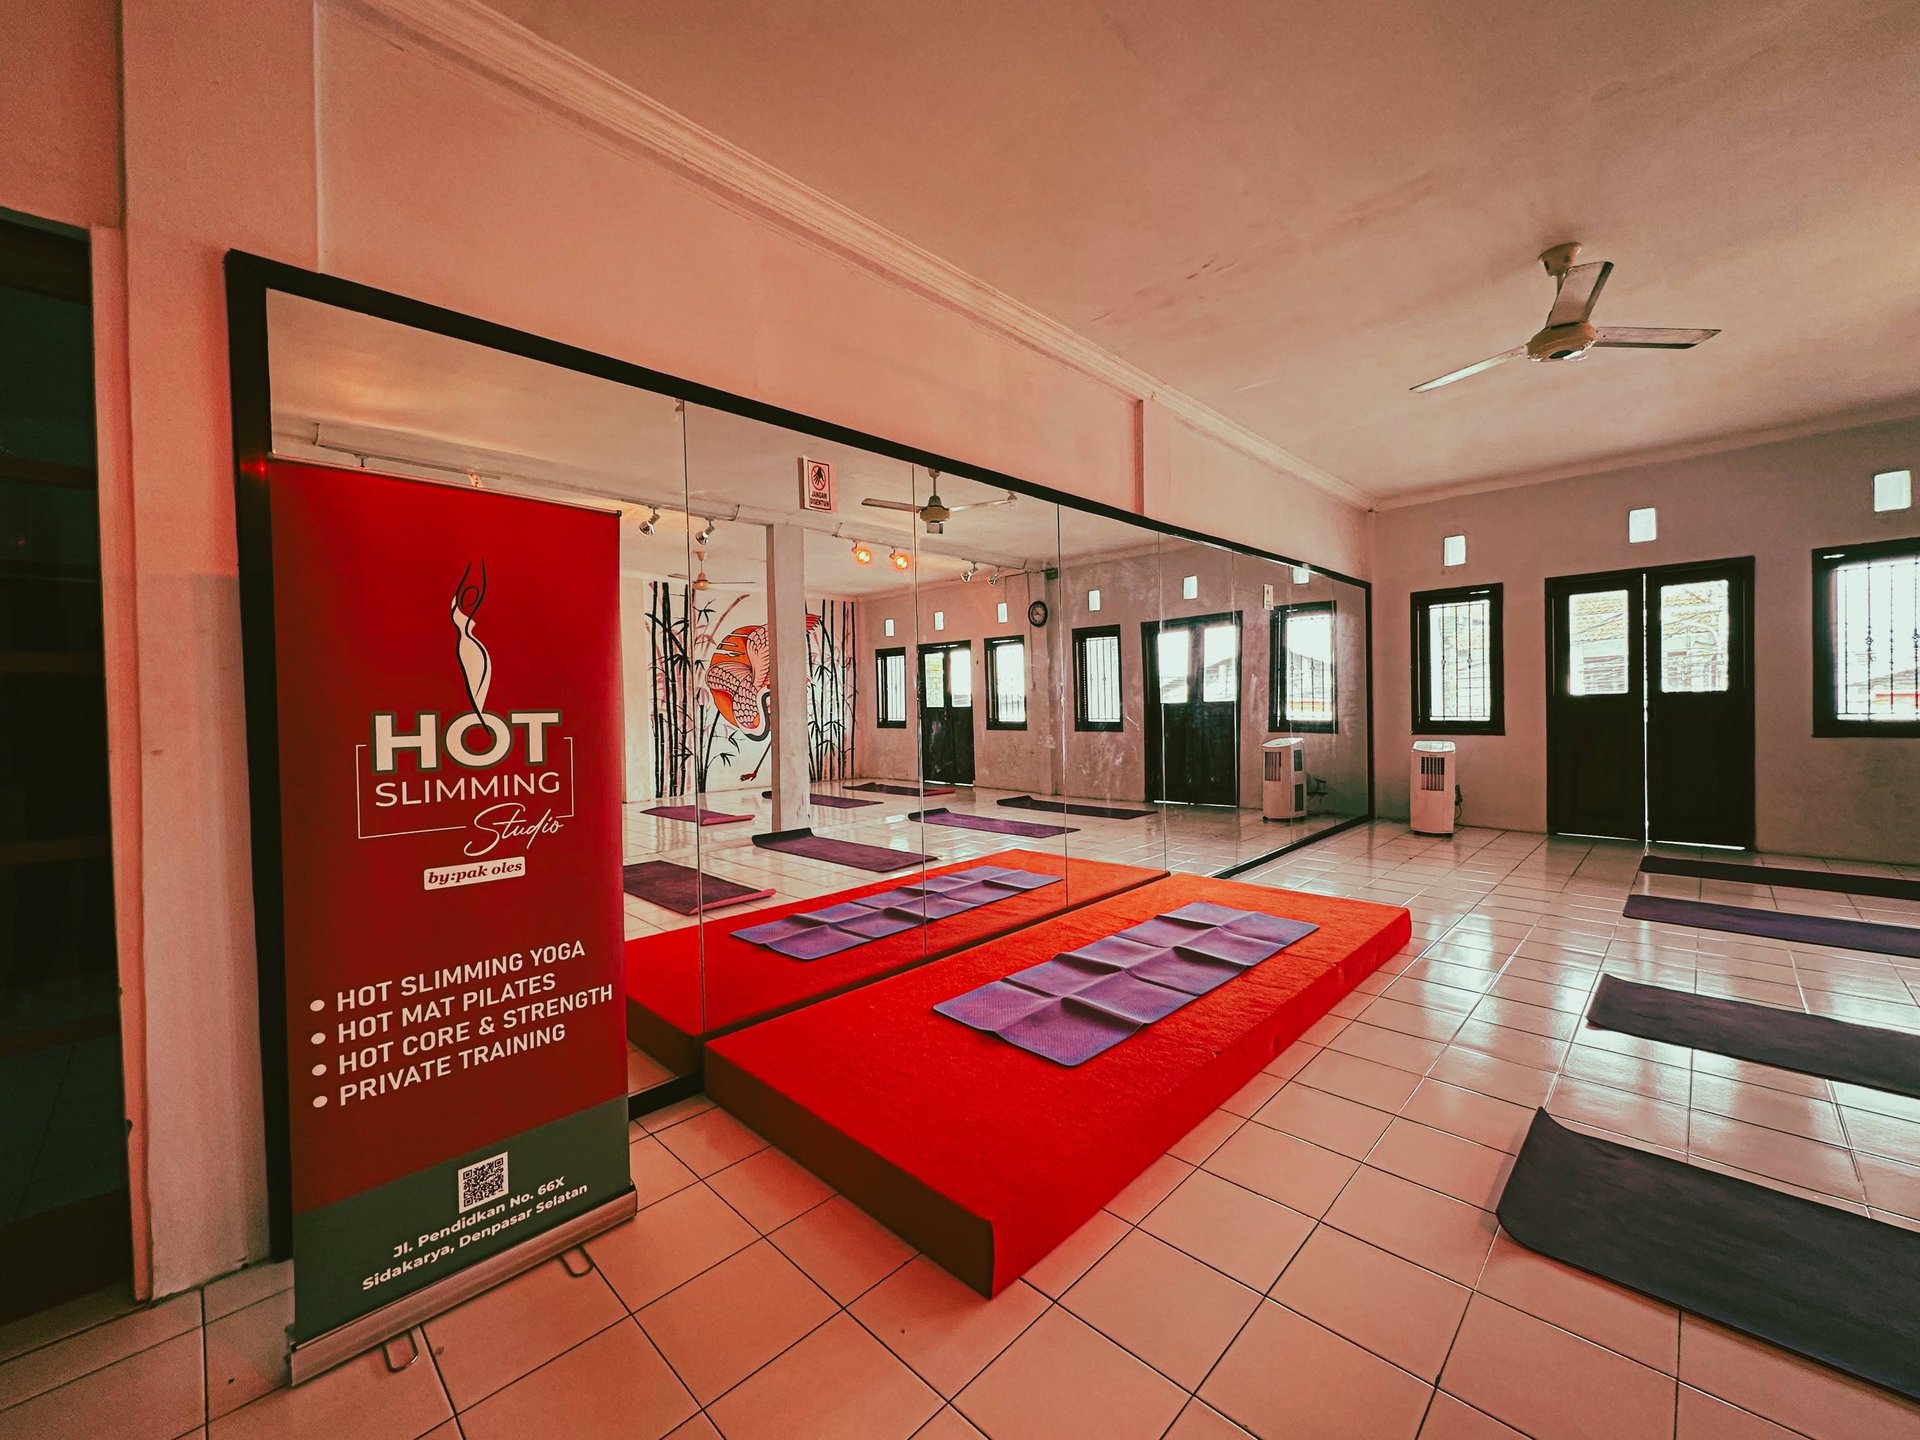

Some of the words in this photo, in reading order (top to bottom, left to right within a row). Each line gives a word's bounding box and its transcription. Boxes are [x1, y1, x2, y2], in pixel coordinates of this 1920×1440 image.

[373, 711, 560, 772] HOT
[375, 772, 560, 807] SLIMMING
[464, 802, 564, 857] Studio
[491, 861, 523, 876] oles
[337, 981, 392, 1012] HOT
[400, 953, 523, 997] SLIMMING
[530, 940, 586, 967] YOGA
[338, 1011, 393, 1043] HOT
[402, 997, 455, 1027] MAT
[463, 973, 556, 1011] PILATES
[339, 1042, 394, 1075] HOT
[402, 1022, 470, 1056] CORE
[478, 1016, 495, 1036] &
[503, 984, 613, 1029] STRENGTH
[340, 1056, 452, 1107] PRIVATE
[458, 1023, 566, 1069] TRAINING
[362, 1247, 455, 1290] Sidakarya,
[459, 1210, 532, 1247] Denpasar
[536, 1184, 588, 1213] Selatan
[418, 1203, 506, 1247] Pendidkan
[510, 1193, 534, 1208] No.
[537, 1176, 565, 1195] 66X
